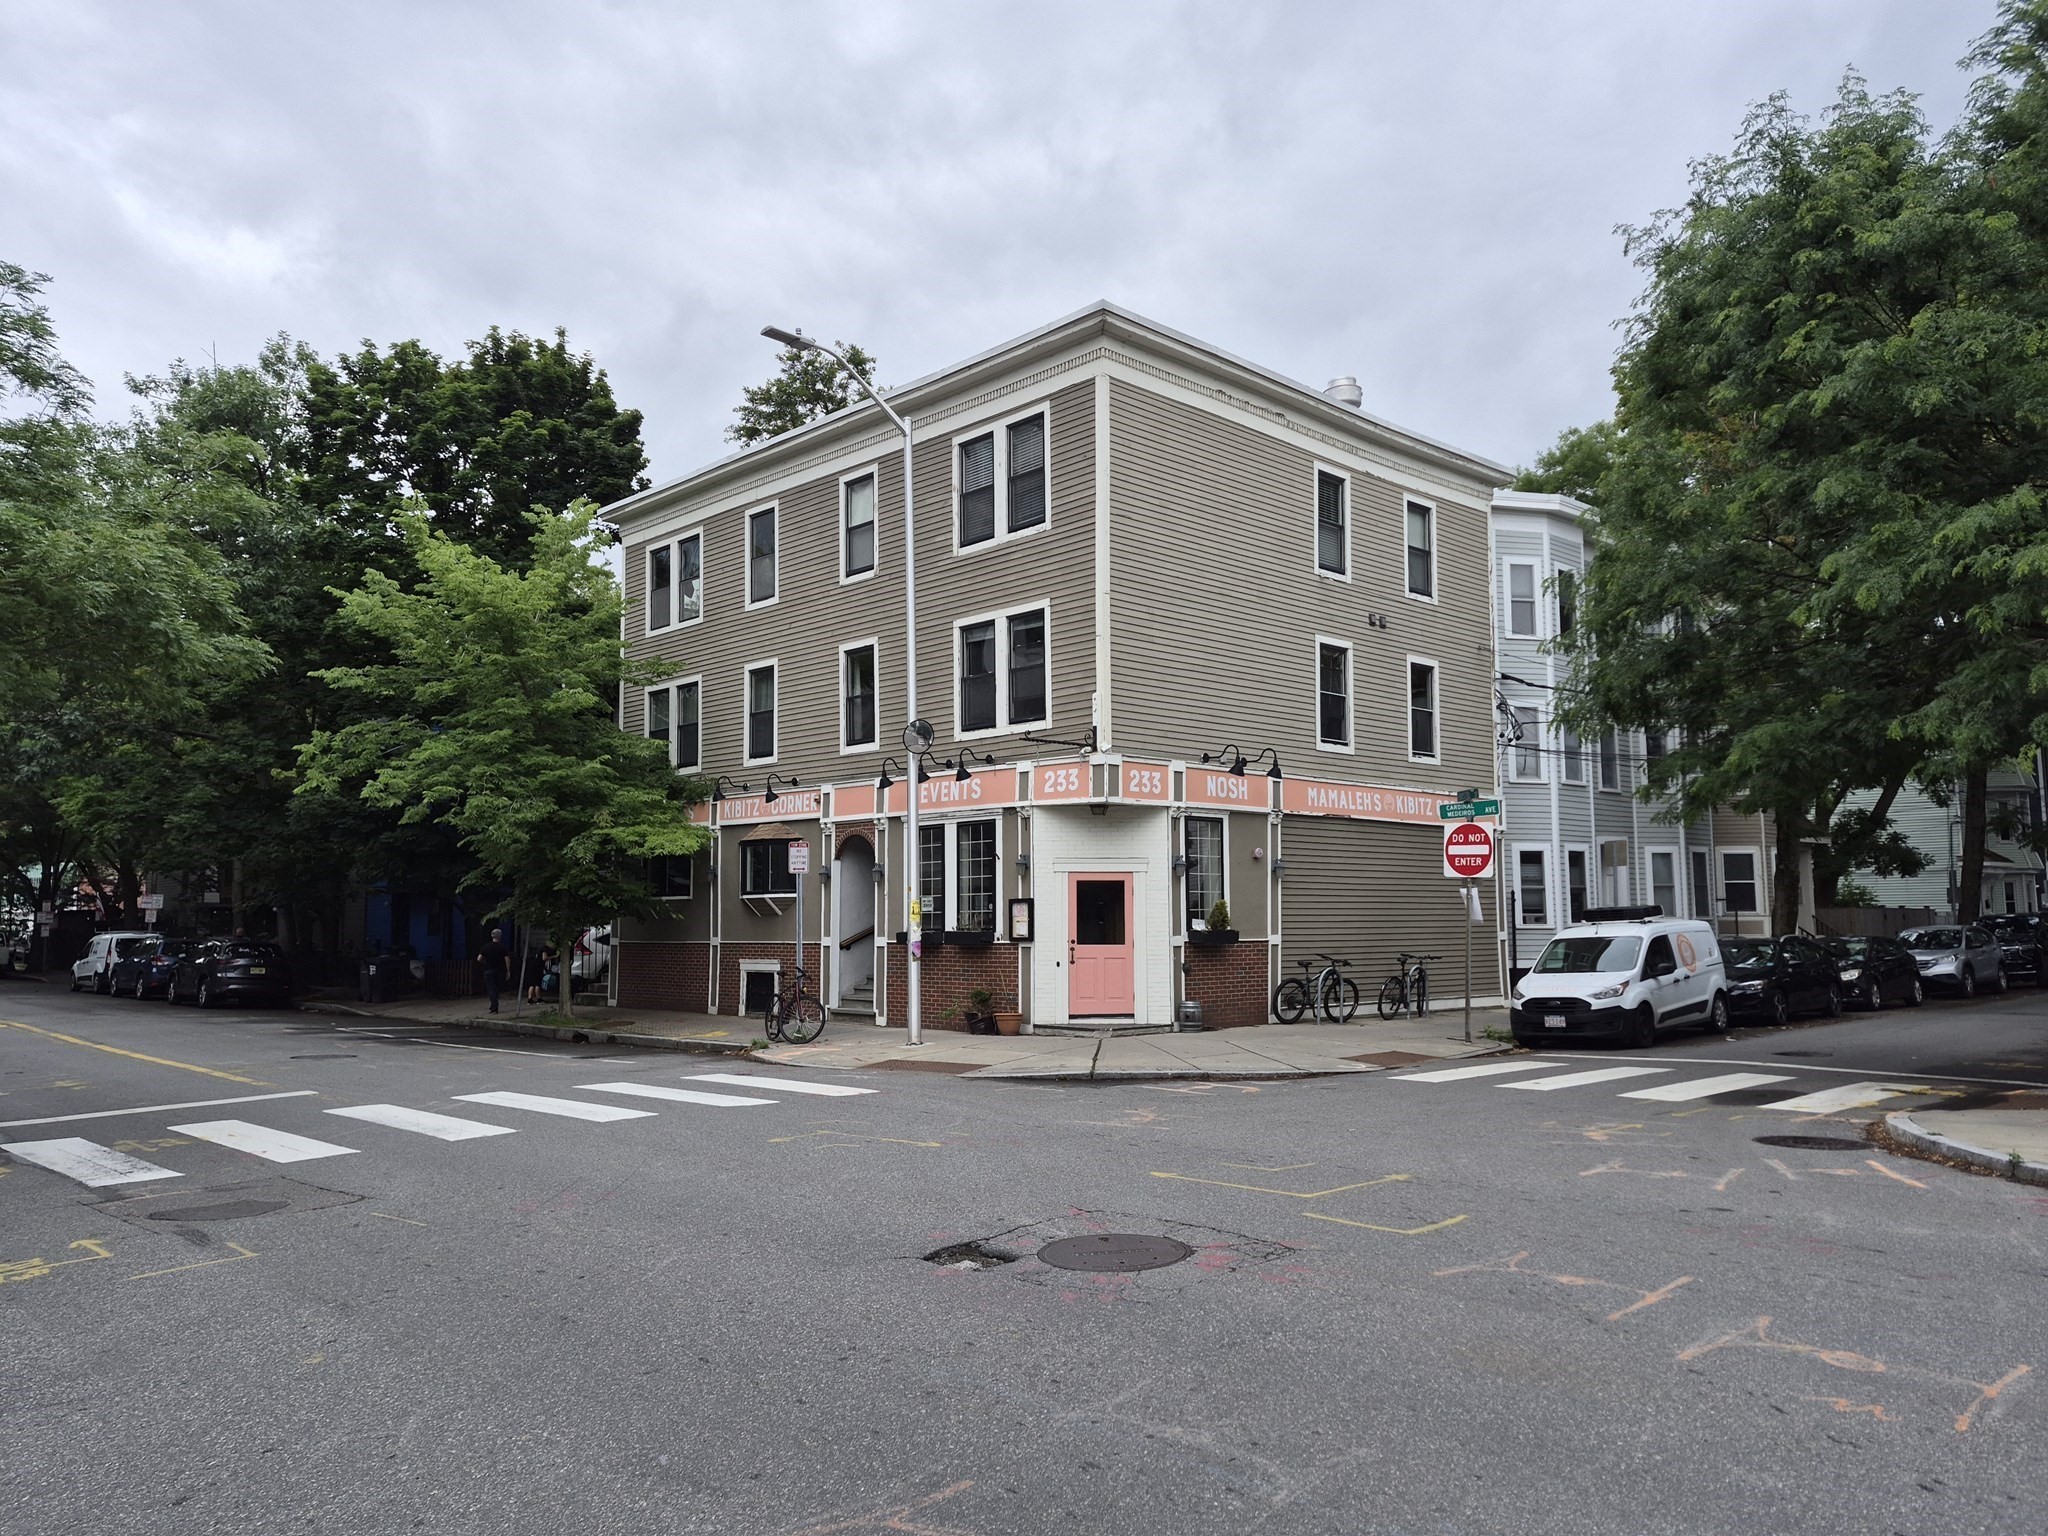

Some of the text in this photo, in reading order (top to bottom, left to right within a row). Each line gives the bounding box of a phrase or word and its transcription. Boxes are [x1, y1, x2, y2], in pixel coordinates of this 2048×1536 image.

[920, 778, 981, 804] EVENTS
[1044, 768, 1079, 793] 233
[1129, 769, 1161, 794] 233
[1206, 775, 1248, 800] NOSH
[724, 792, 818, 819] KIBITZ CORNER
[1307, 787, 1382, 812] MAMALEH'S
[1396, 795, 1433, 816] KIBITZ
[1446, 803, 1475, 811] CARDINAL
[1485, 805, 1496, 813] AVE
[1452, 833, 1486, 842] DO NOT
[1455, 857, 1482, 866] ENTER
